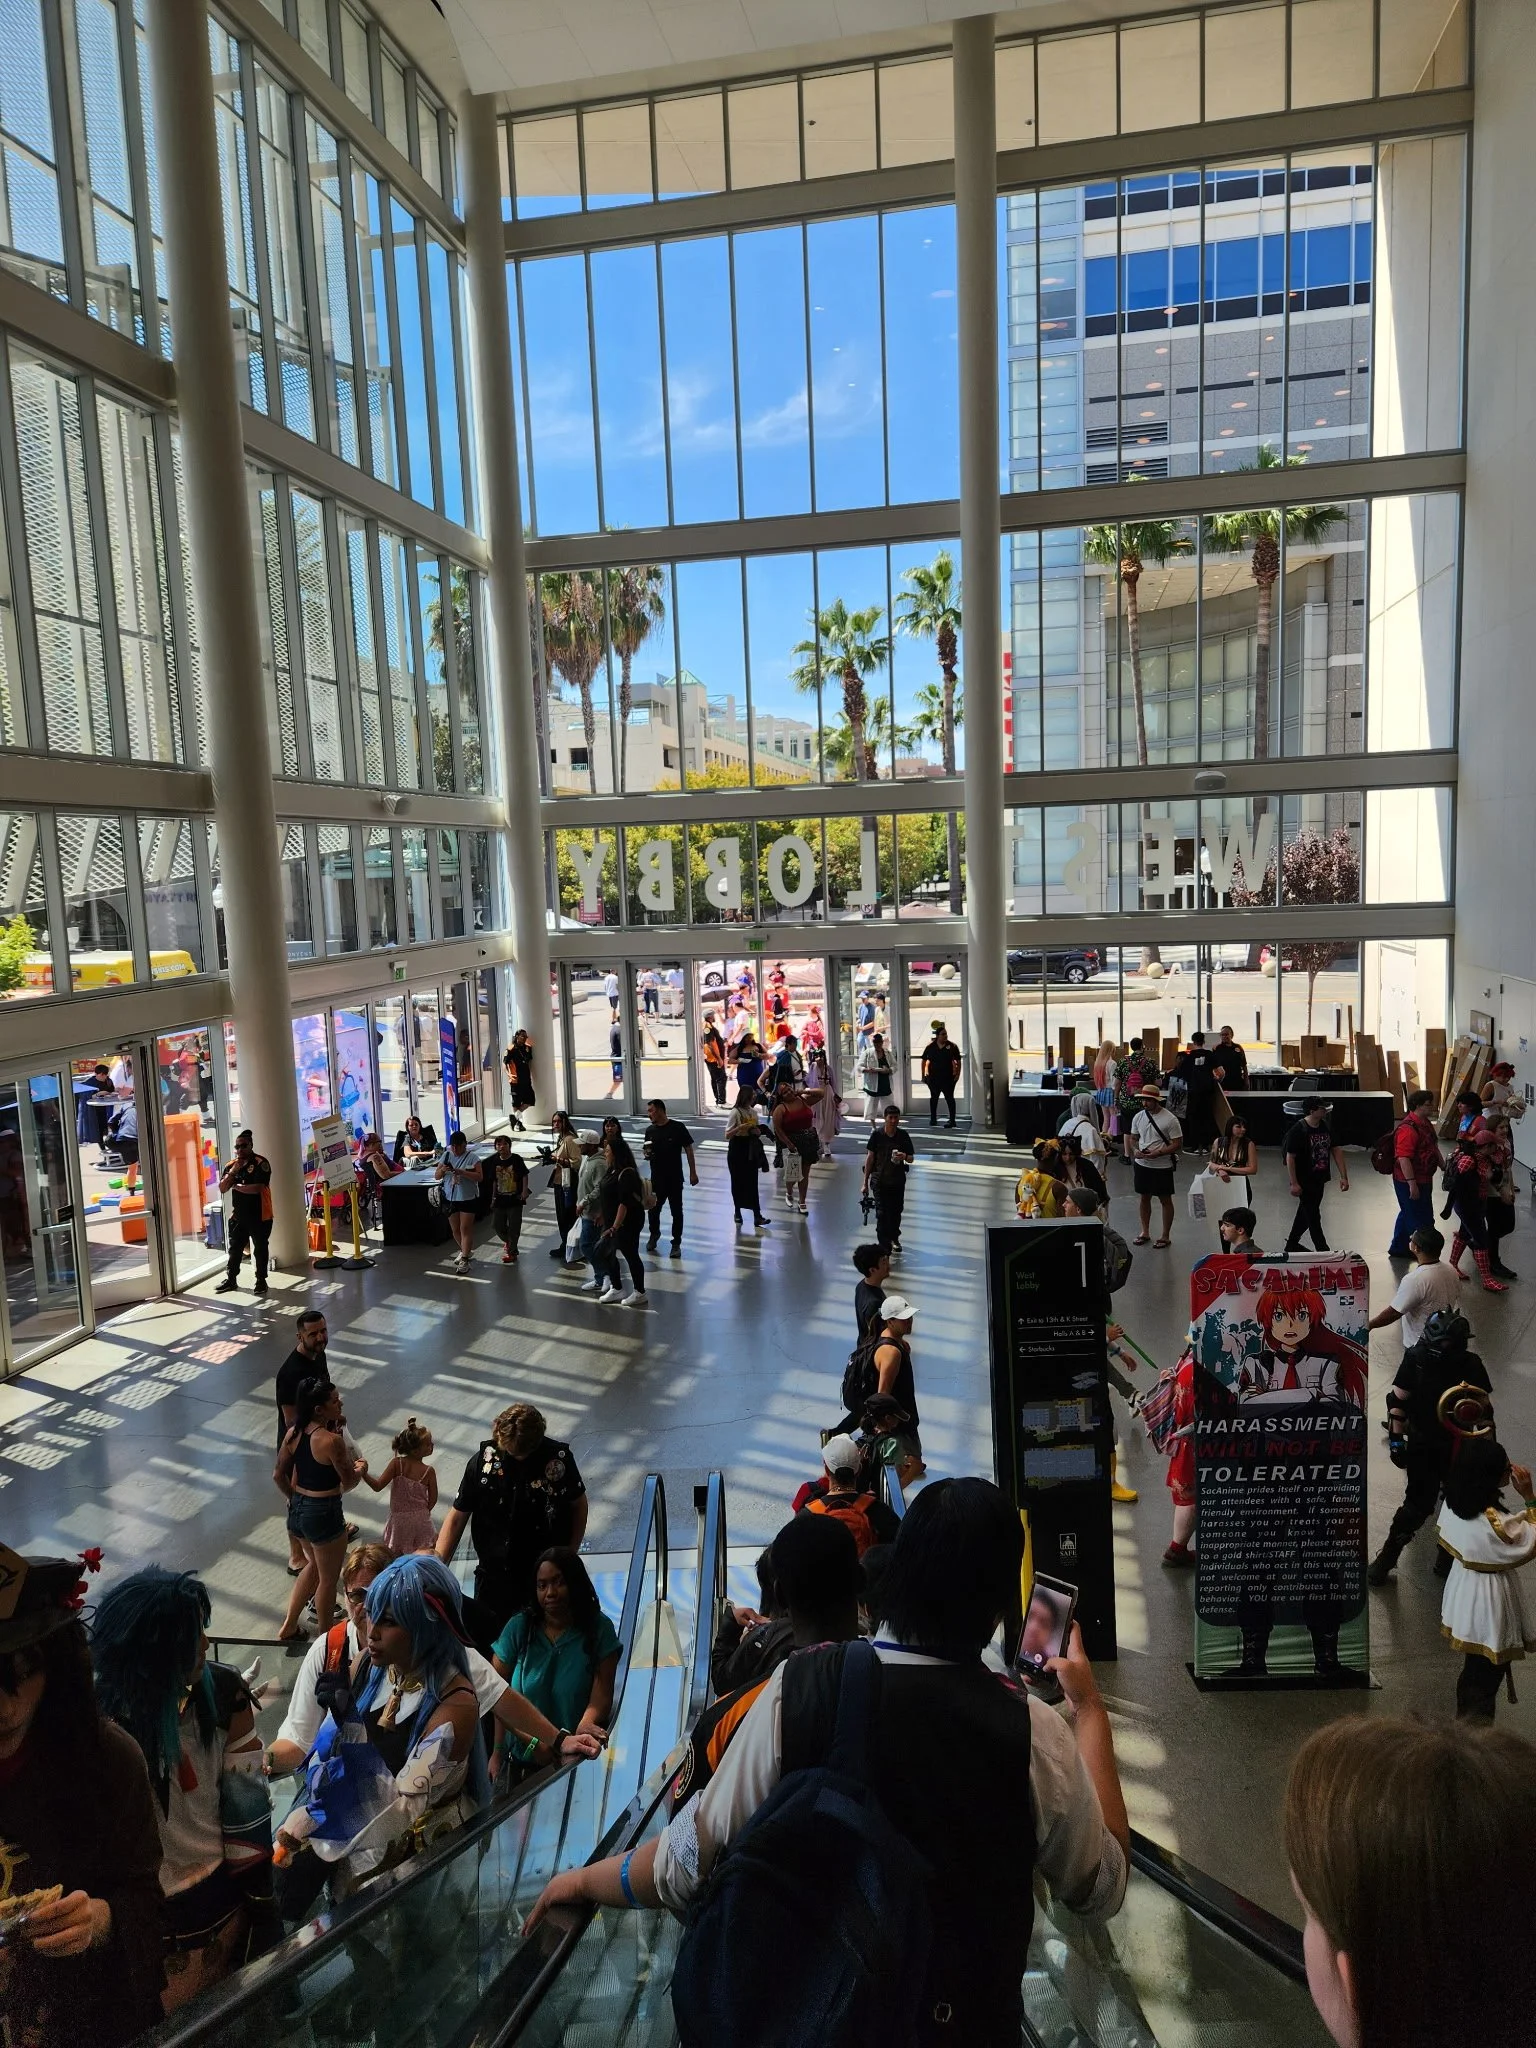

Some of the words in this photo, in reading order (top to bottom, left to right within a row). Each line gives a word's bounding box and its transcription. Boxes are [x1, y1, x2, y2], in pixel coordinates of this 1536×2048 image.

[749, 940, 763, 951] EXIT
[1073, 1241, 1087, 1288] 1
[1015, 1271, 1036, 1279] West
[1193, 1266, 1366, 1294] SACANIME
[1016, 1280, 1040, 1291] Lobby
[1197, 1415, 1363, 1434] HARASSMENT
[1198, 1441, 1256, 1458] WILL
[1266, 1440, 1320, 1457] NOT
[1330, 1439, 1362, 1457] BE
[1198, 1464, 1361, 1483] TOLERATED
[1201, 1486, 1244, 1495] SacAnime
[1246, 1486, 1274, 1496] prides
[1278, 1485, 1300, 1493] itself
[1318, 1484, 1360, 1494] providing
[1221, 1496, 1265, 1505] attendees
[1270, 1496, 1290, 1504] with
[1306, 1495, 1326, 1504] safe,
[1332, 1494, 1360, 1504] family
[1201, 1508, 1236, 1517] friendly
[1240, 1508, 1299, 1516] environment.
[1308, 1506, 1315, 1514] If
[1201, 1520, 1245, 1528] harasses
[1290, 1518, 1320, 1526] treats
[1325, 1518, 1344, 1526] you
[1200, 1531, 1247, 1539] someone
[1256, 1530, 1276, 1539] you
[1287, 1528, 1315, 1537] know
[1200, 1540, 1260, 1550] inappropriate
[1262, 1540, 1298, 1548] manner,
[1301, 1539, 1329, 1549] please
[1331, 1538, 1360, 1548] report
[1200, 1552, 1210, 1560] to
[1222, 1551, 1242, 1561] gold
[1302, 1550, 1360, 1558] immediately.
[1200, 1562, 1248, 1570] Individuals
[1323, 1562, 1341, 1570] way
[1303, 1572, 1330, 1580] event.
[1344, 1571, 1360, 1579] Not
[1200, 1584, 1242, 1593] reporting
[1248, 1584, 1268, 1592] only
[1273, 1582, 1324, 1590] contributes
[1200, 1595, 1241, 1603] behavior.
[1250, 1594, 1268, 1602] YOU
[1330, 1592, 1346, 1600] line
[1350, 1592, 1360, 1600] of
[1200, 1606, 1237, 1614] defense.
